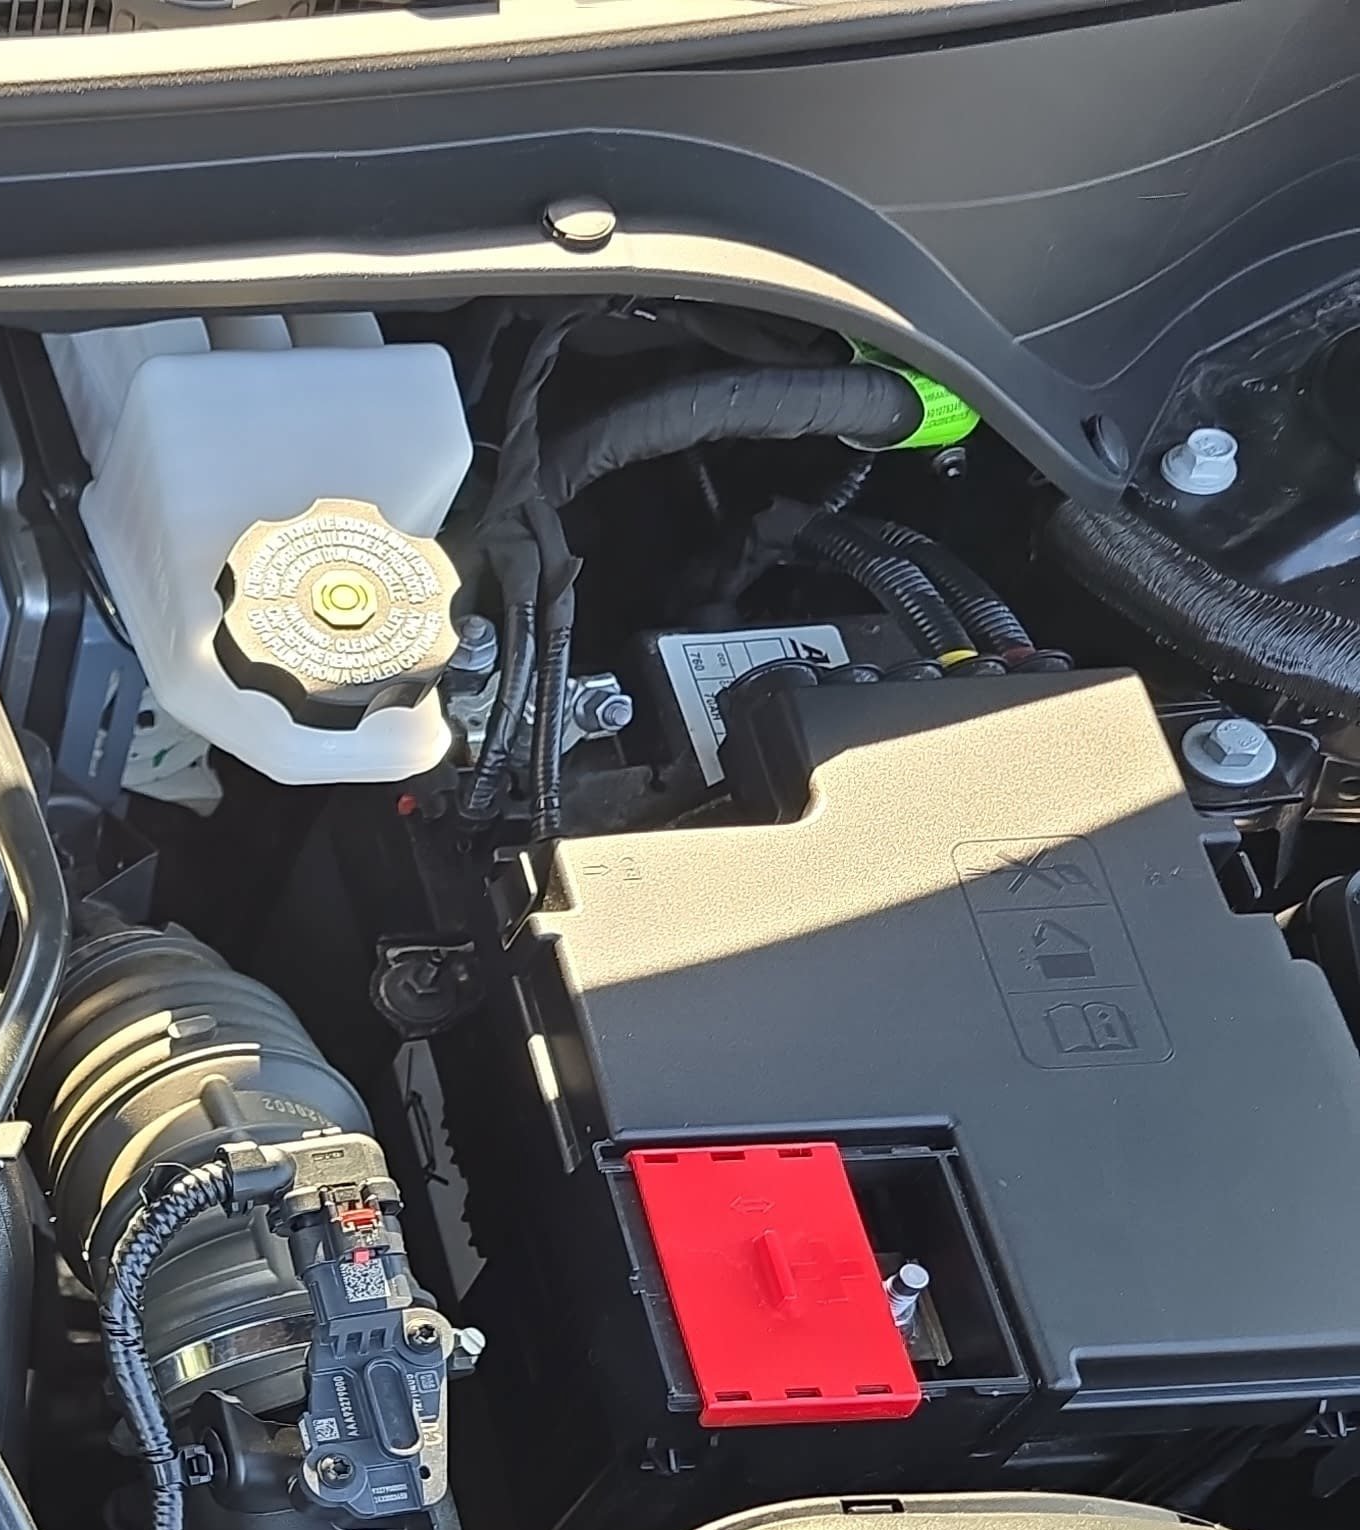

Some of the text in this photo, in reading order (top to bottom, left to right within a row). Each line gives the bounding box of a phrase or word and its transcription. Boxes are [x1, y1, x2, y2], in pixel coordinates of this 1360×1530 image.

[264, 606, 289, 632] CAP
[333, 633, 381, 653] CLEAN
[373, 606, 407, 642] FILLER
[399, 609, 427, 640] ONLY
[263, 635, 304, 671] FLUID
[297, 659, 339, 684] FROM
[350, 659, 403, 684] SEALED
[394, 611, 446, 670] CONTAINER
[276, 626, 325, 664] BEFORE
[690, 652, 704, 672] 760
